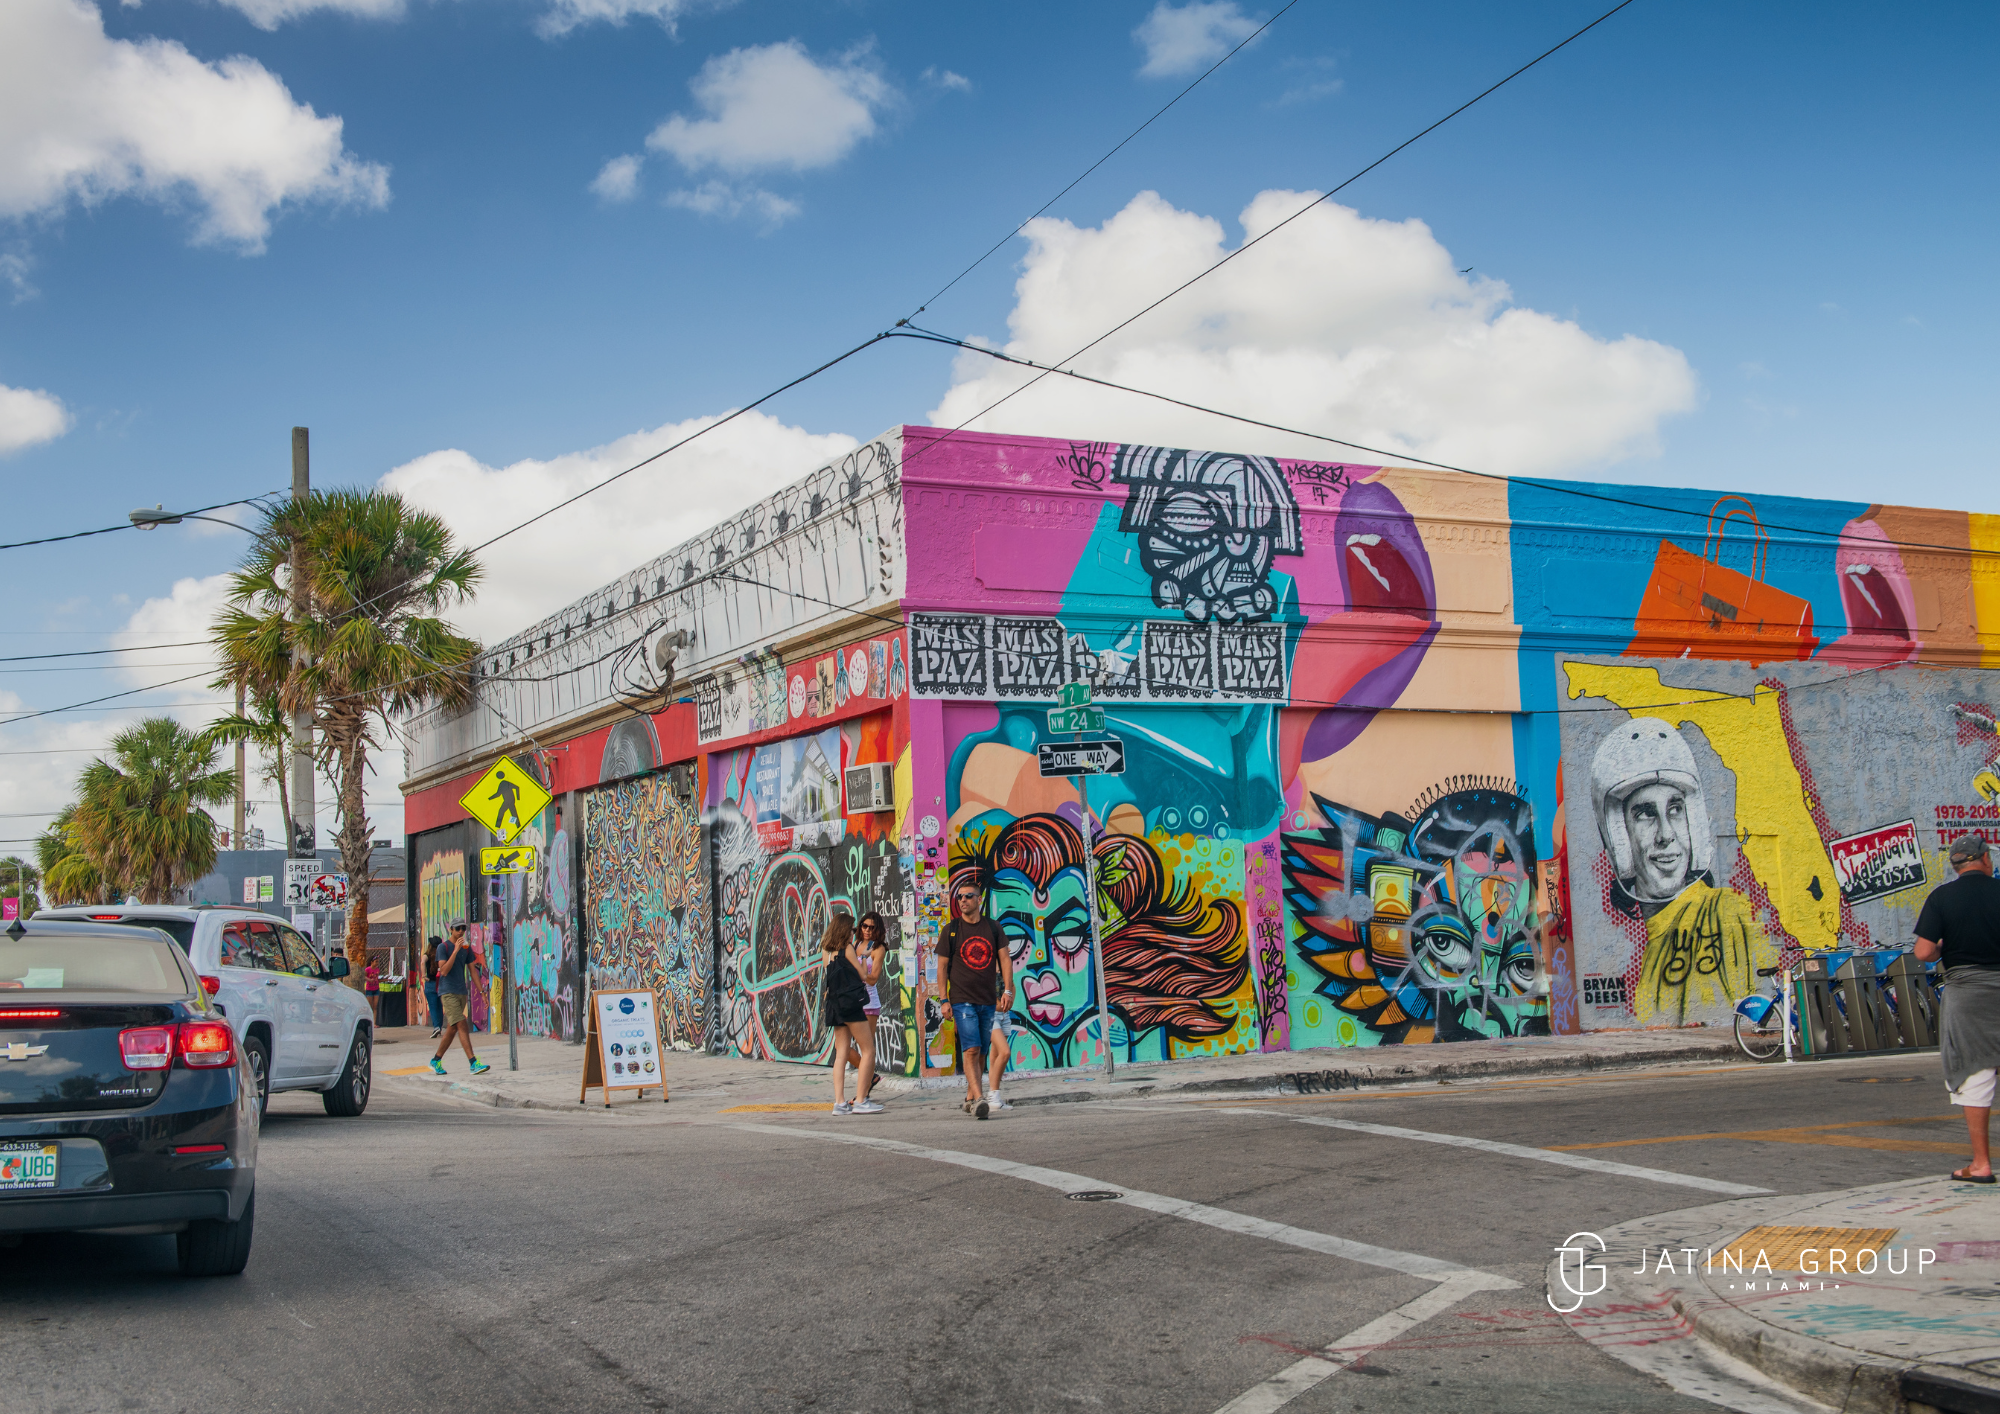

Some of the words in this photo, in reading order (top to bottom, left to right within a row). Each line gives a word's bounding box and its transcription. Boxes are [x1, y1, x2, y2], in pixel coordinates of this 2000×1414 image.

[916, 623, 980, 650] MAS
[997, 626, 1059, 653] MAS
[1150, 631, 1206, 657] MAS
[1221, 632, 1278, 658] MAS
[917, 650, 982, 683] PAZ
[998, 653, 1061, 686] PAZ
[1150, 656, 1209, 687] PAZ
[1222, 657, 1280, 689] PAZ
[1069, 687, 1075, 705] 2
[1051, 717, 1064, 729] NW
[1069, 712, 1088, 730] 24
[1095, 715, 1105, 728] ST
[1055, 752, 1077, 766] ONE
[1086, 751, 1109, 764] WAY
[1934, 805, 2000, 819] 1978-2018
[1838, 826, 1918, 893] Skateboard
[292, 874, 307, 882] LIM
[1882, 863, 1916, 887] USA
[1583, 977, 1625, 991] BRYAN
[1584, 990, 1627, 1004] DEESE
[100, 1088, 139, 1096] MALIBU
